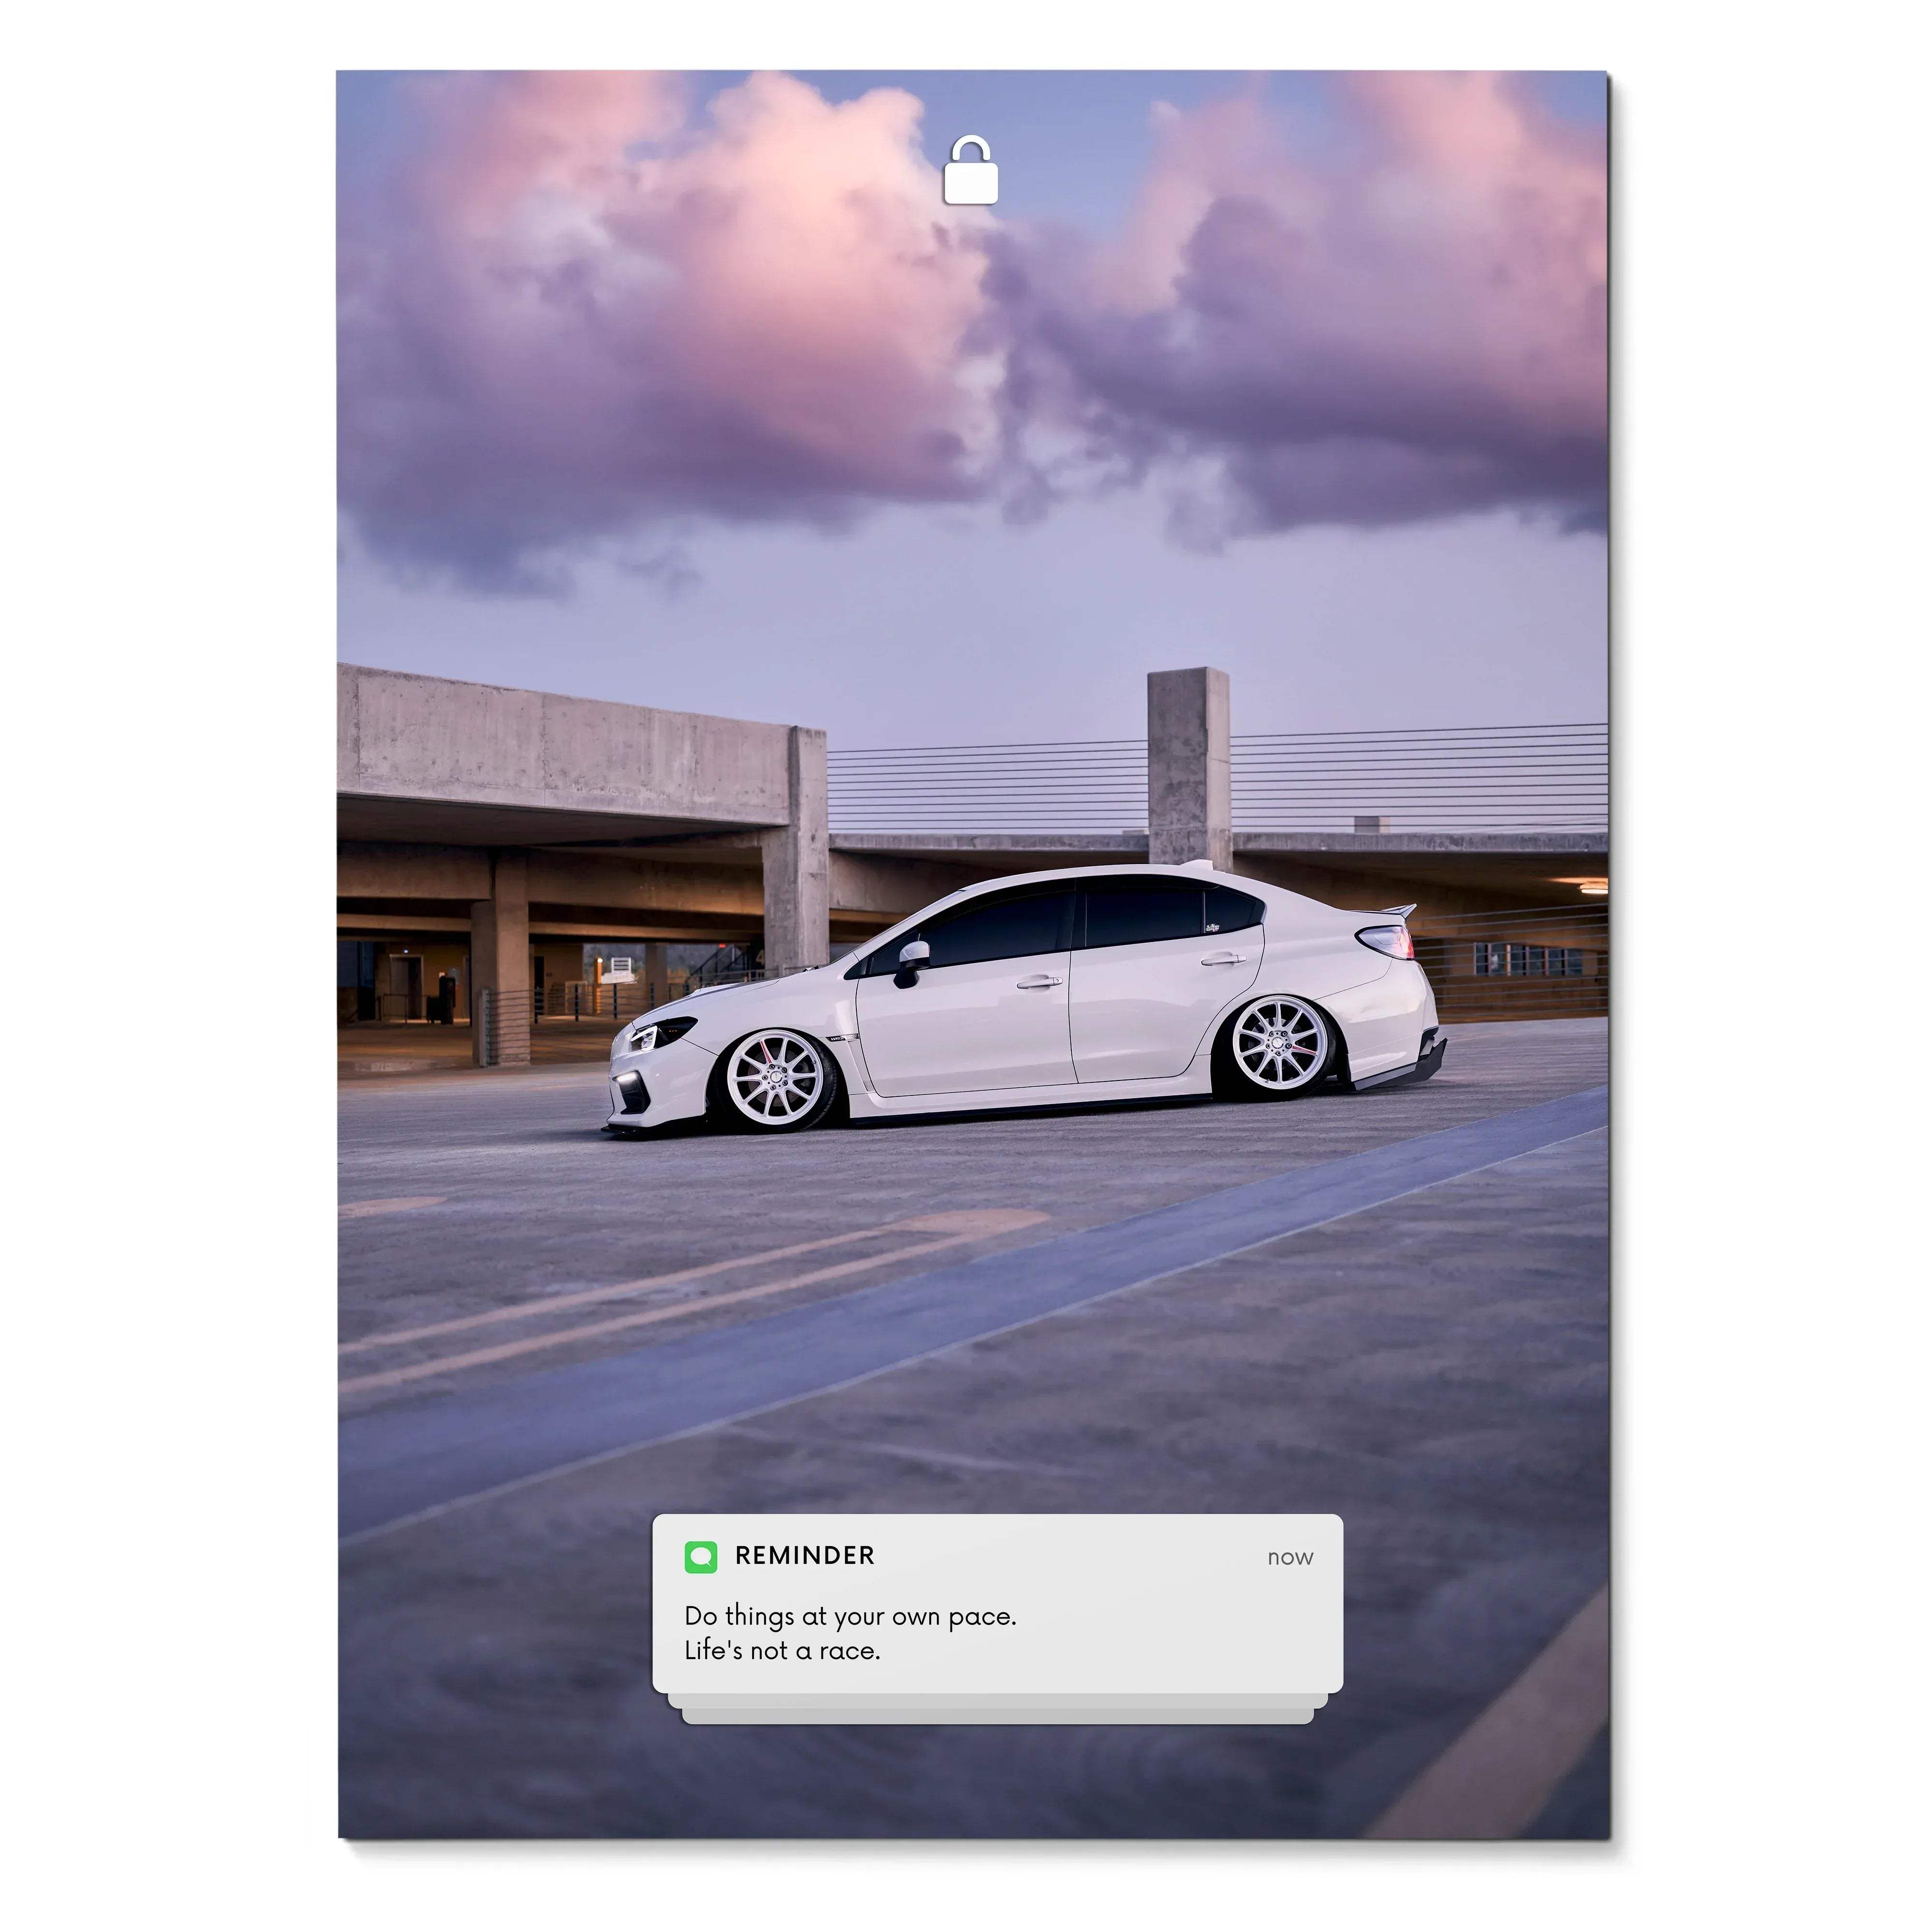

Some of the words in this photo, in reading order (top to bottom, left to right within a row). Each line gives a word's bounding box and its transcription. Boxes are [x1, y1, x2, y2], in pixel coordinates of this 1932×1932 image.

[737, 1546, 875, 1564] REMINDER
[1269, 1552, 1314, 1565] now
[686, 1605, 717, 1625] Do
[725, 1601, 794, 1633] things
[802, 1606, 827, 1625] at
[834, 1611, 885, 1633] your
[893, 1611, 939, 1625] own
[950, 1611, 1016, 1633] pace.
[686, 1636, 742, 1660] Life's
[752, 1641, 788, 1660] not
[796, 1646, 812, 1660] a
[821, 1646, 880, 1660] race.
